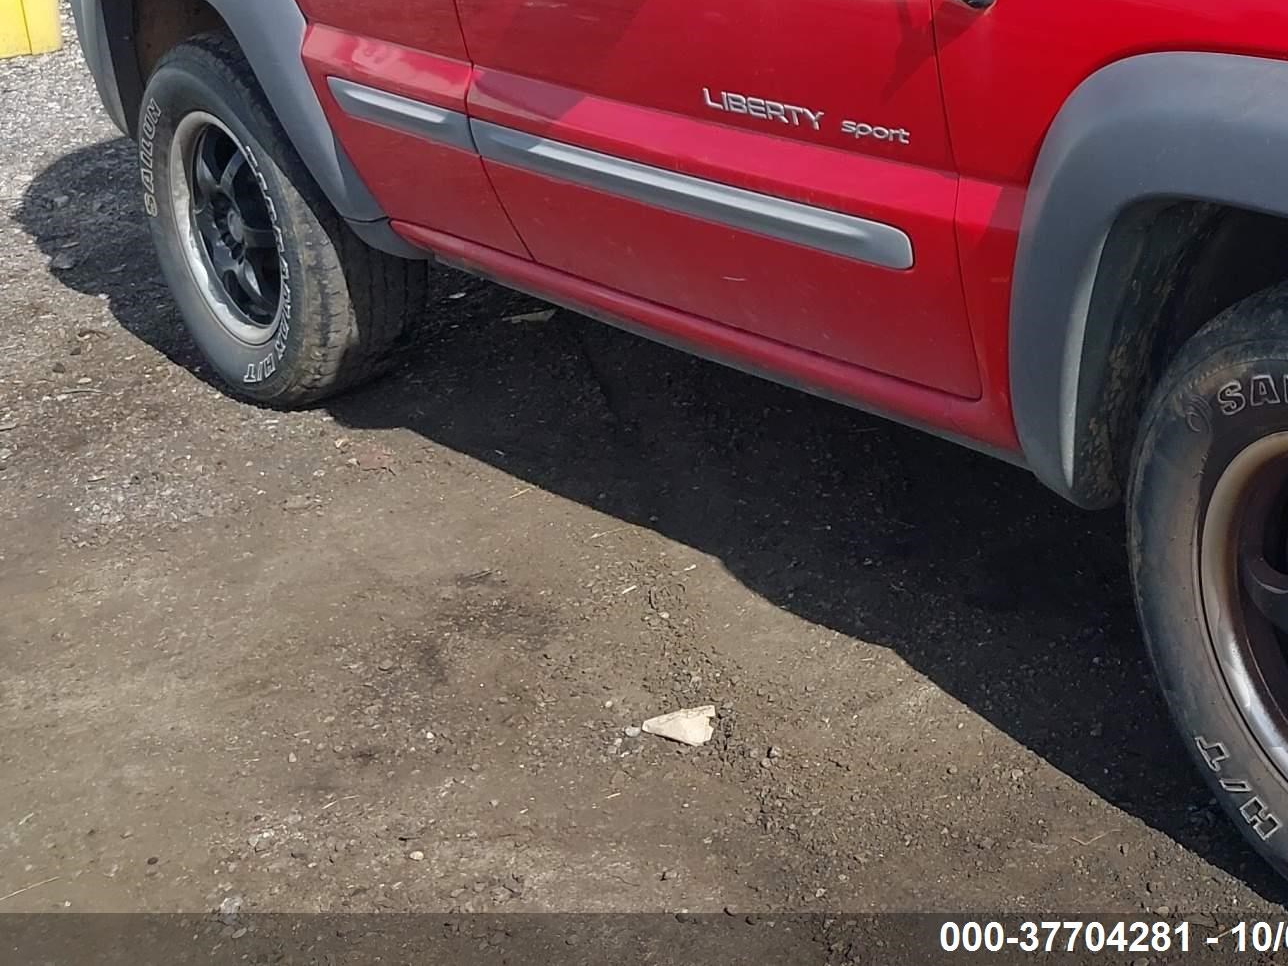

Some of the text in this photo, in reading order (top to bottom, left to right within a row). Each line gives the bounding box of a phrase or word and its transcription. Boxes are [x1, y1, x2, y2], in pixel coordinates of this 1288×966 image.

[140, 97, 162, 217] SAILUN
[702, 86, 911, 145] LIBERTY sport
[1195, 736, 1283, 841] H/T
